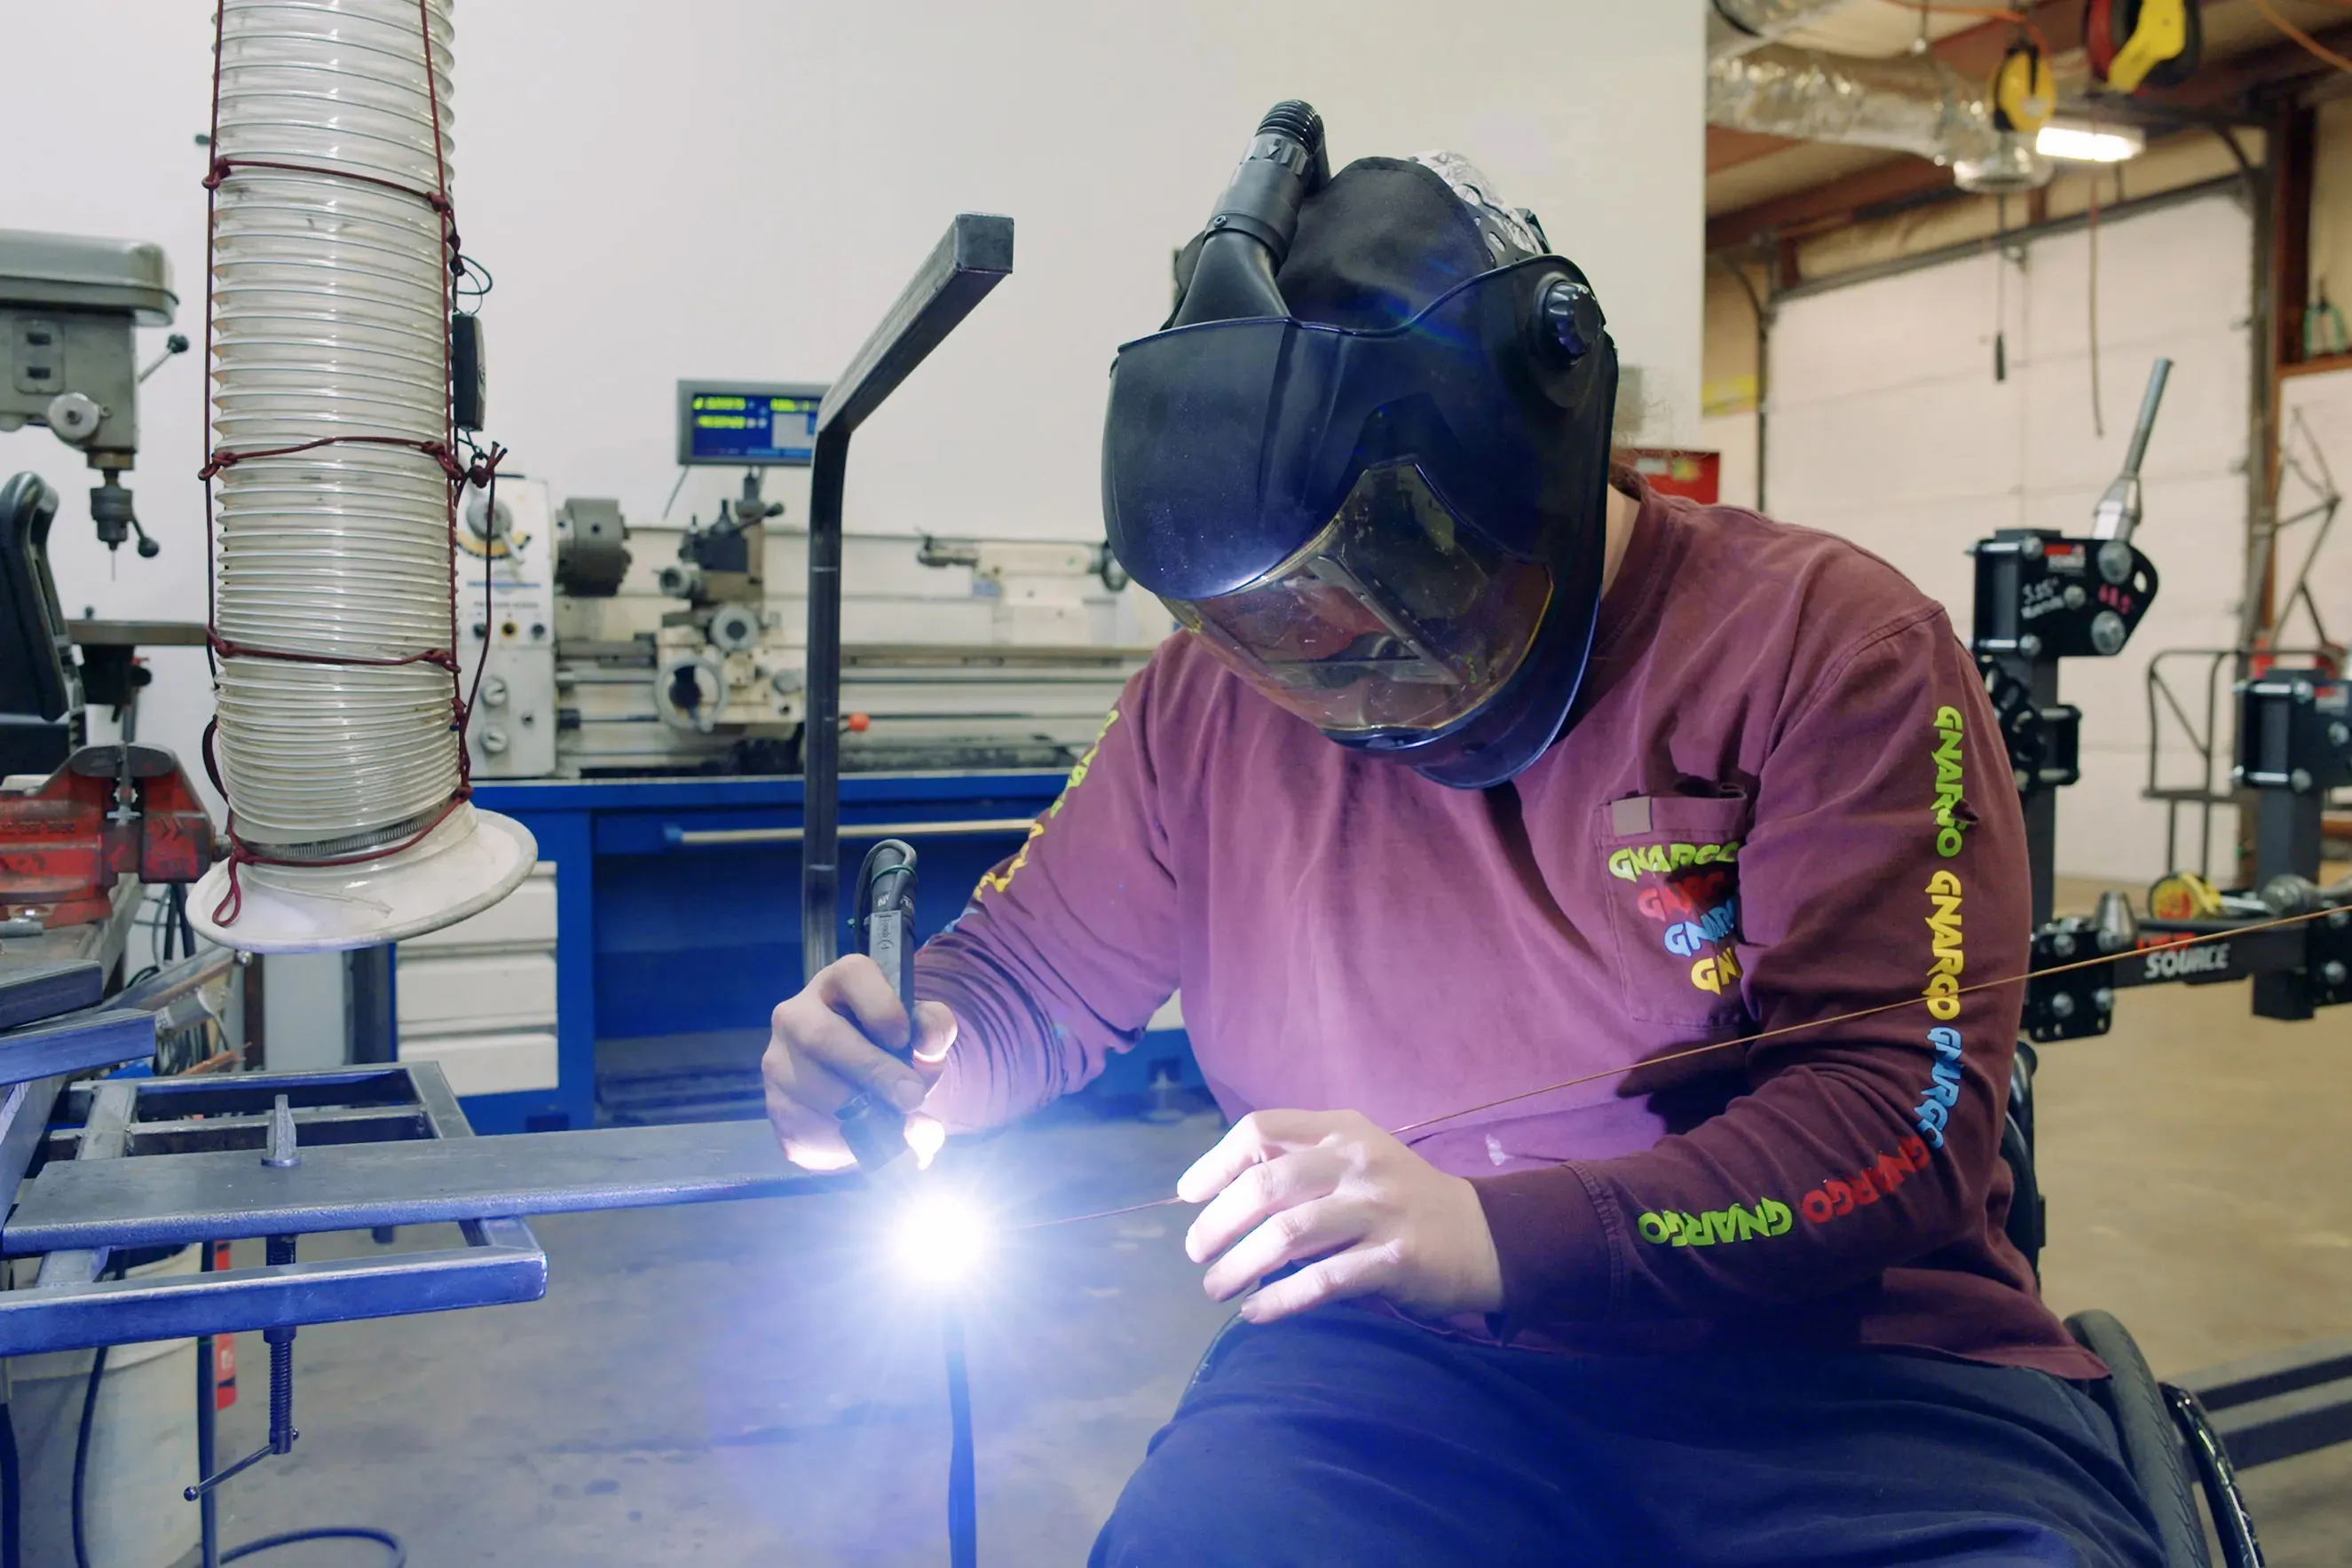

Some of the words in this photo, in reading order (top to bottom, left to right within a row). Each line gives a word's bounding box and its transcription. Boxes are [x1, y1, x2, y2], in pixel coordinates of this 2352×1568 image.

[1922, 870, 1964, 1020] GNARGO
[2143, 942, 2231, 979] SOURCE
[1637, 1196, 1793, 1248] GNARGO
